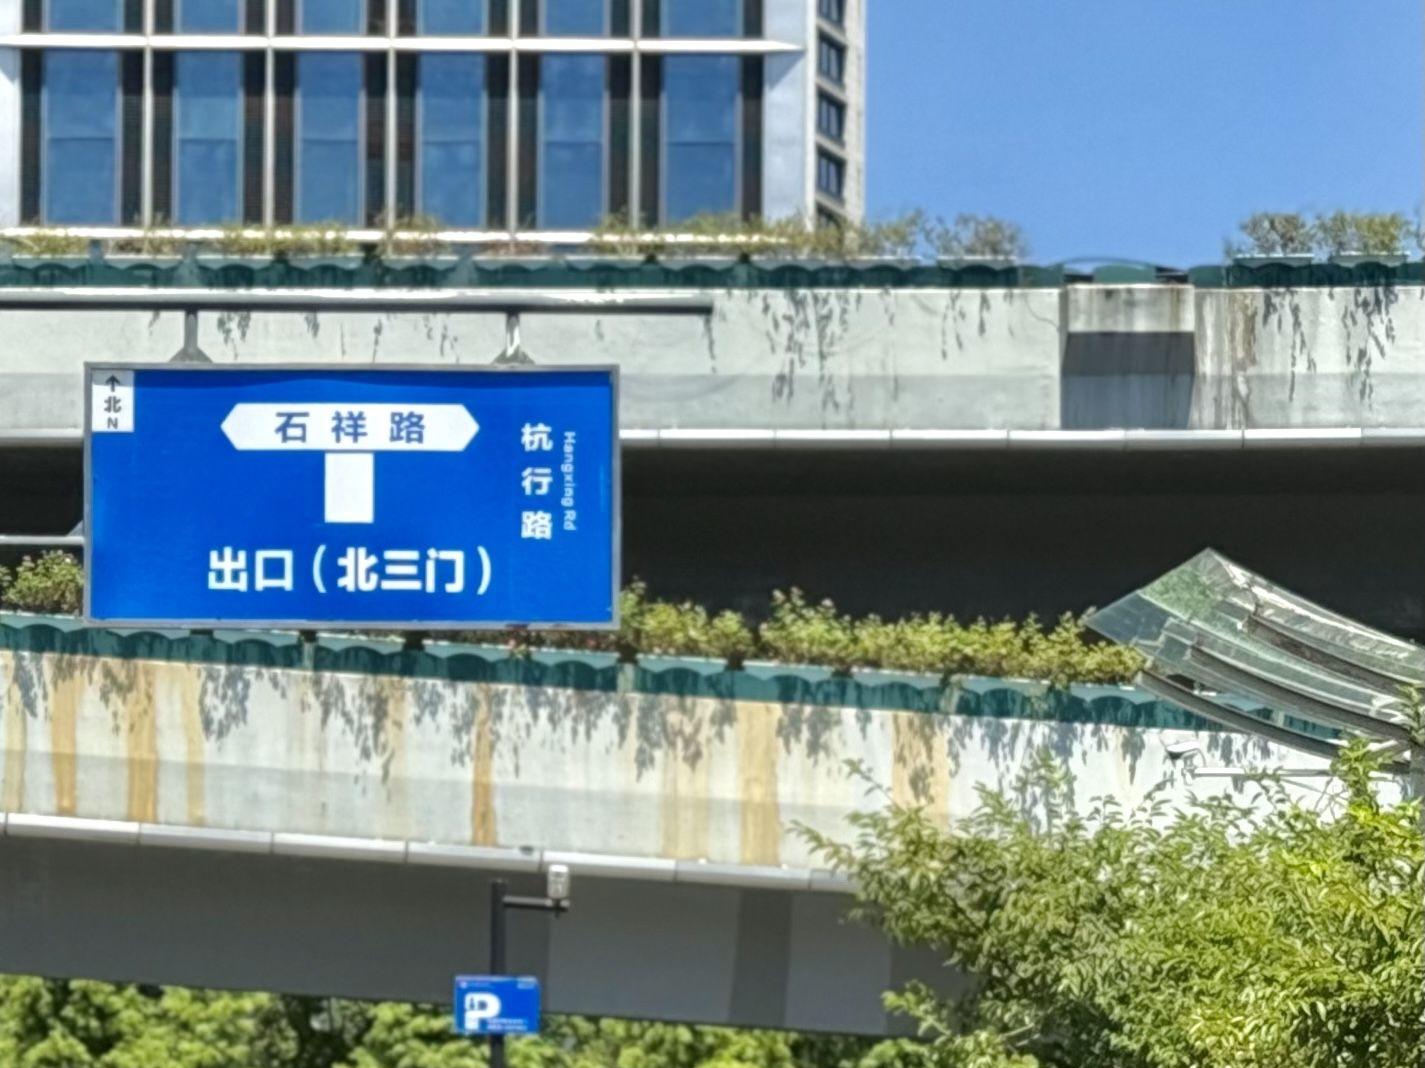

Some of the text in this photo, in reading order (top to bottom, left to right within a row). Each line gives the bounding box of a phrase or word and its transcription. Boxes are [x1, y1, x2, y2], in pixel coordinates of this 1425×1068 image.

[104, 396, 122, 413] 北
[107, 417, 118, 430] N
[275, 411, 426, 444] 石祥路
[521, 422, 553, 540] 杭行路
[560, 431, 577, 531] Hangxing Rd
[464, 992, 502, 1030] P
